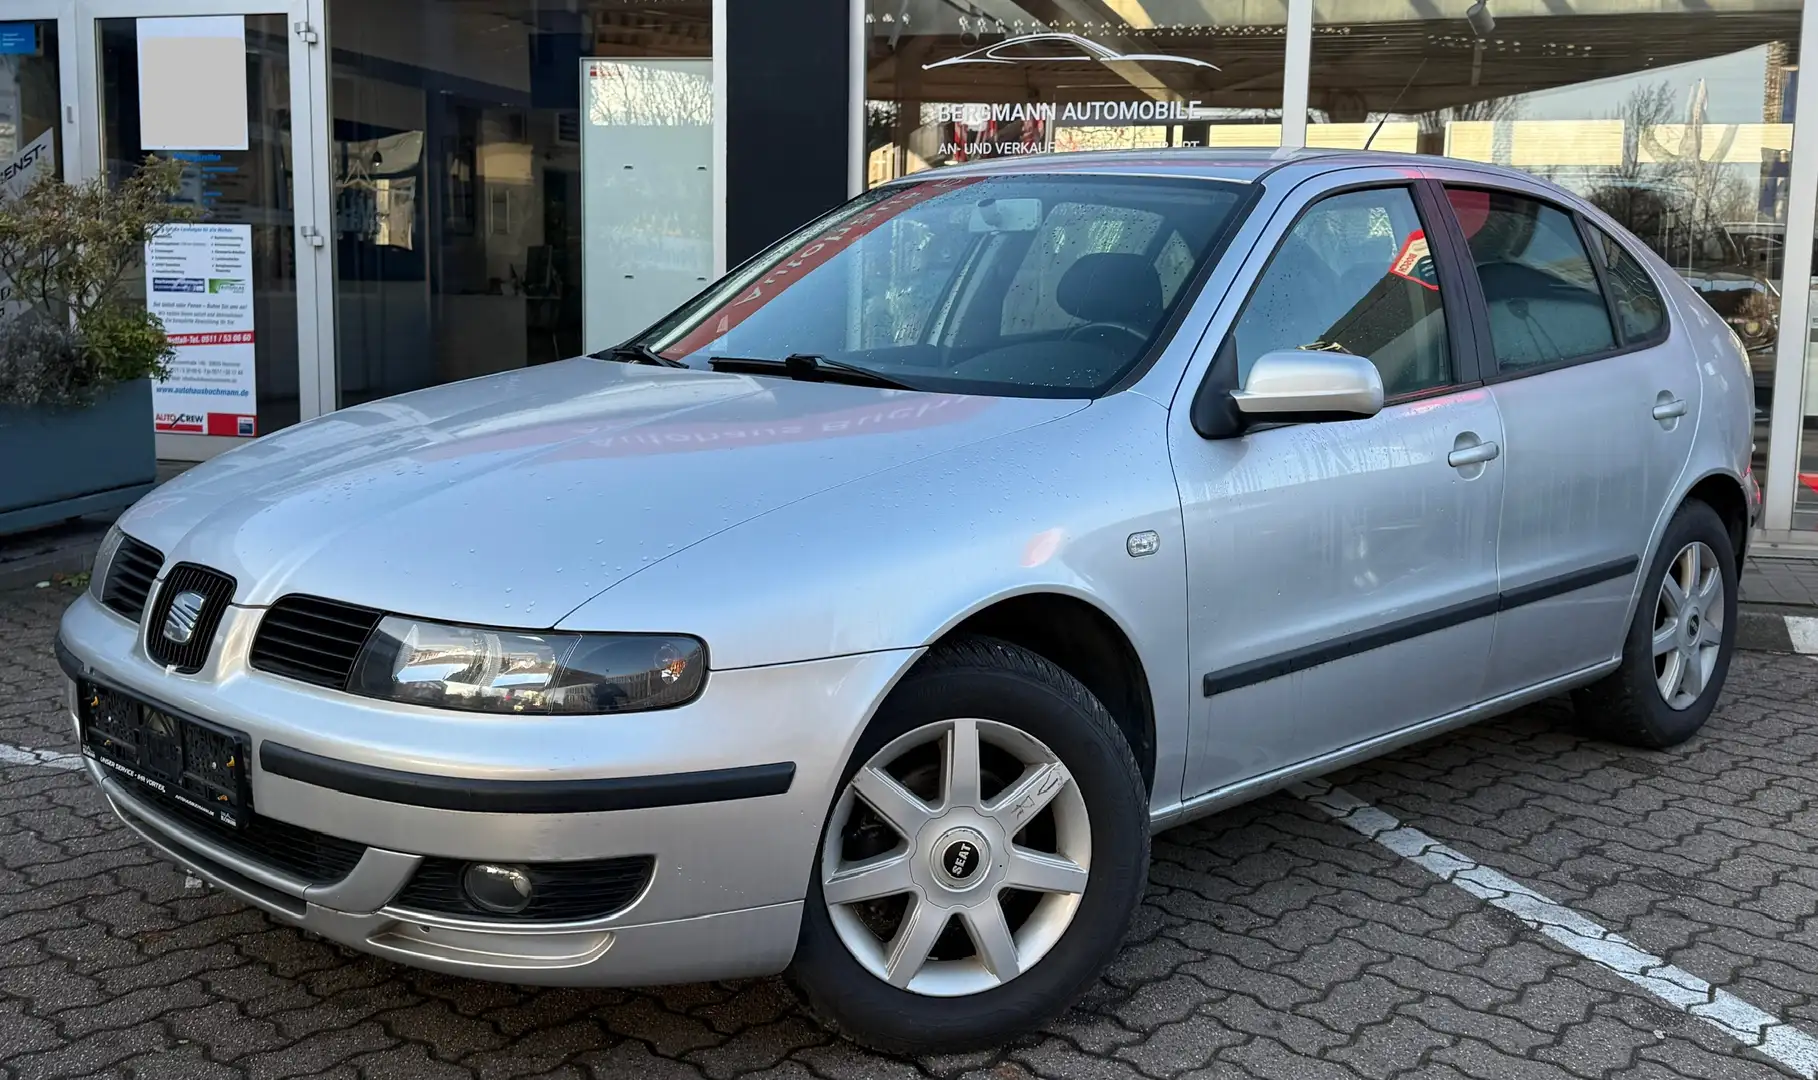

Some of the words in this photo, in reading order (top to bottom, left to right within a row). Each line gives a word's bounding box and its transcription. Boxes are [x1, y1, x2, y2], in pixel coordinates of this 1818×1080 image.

[938, 102, 1056, 122] BERGMANN
[1063, 100, 1202, 121] AUTOMOBILE
[938, 142, 961, 155] AN-
[964, 142, 992, 155] UND
[996, 141, 1055, 154] VERKAUF
[201, 334, 217, 343] 0511
[99, 756, 116, 769] UNSER
[114, 763, 135, 778] SERVICE
[951, 843, 971, 876] SEAT
